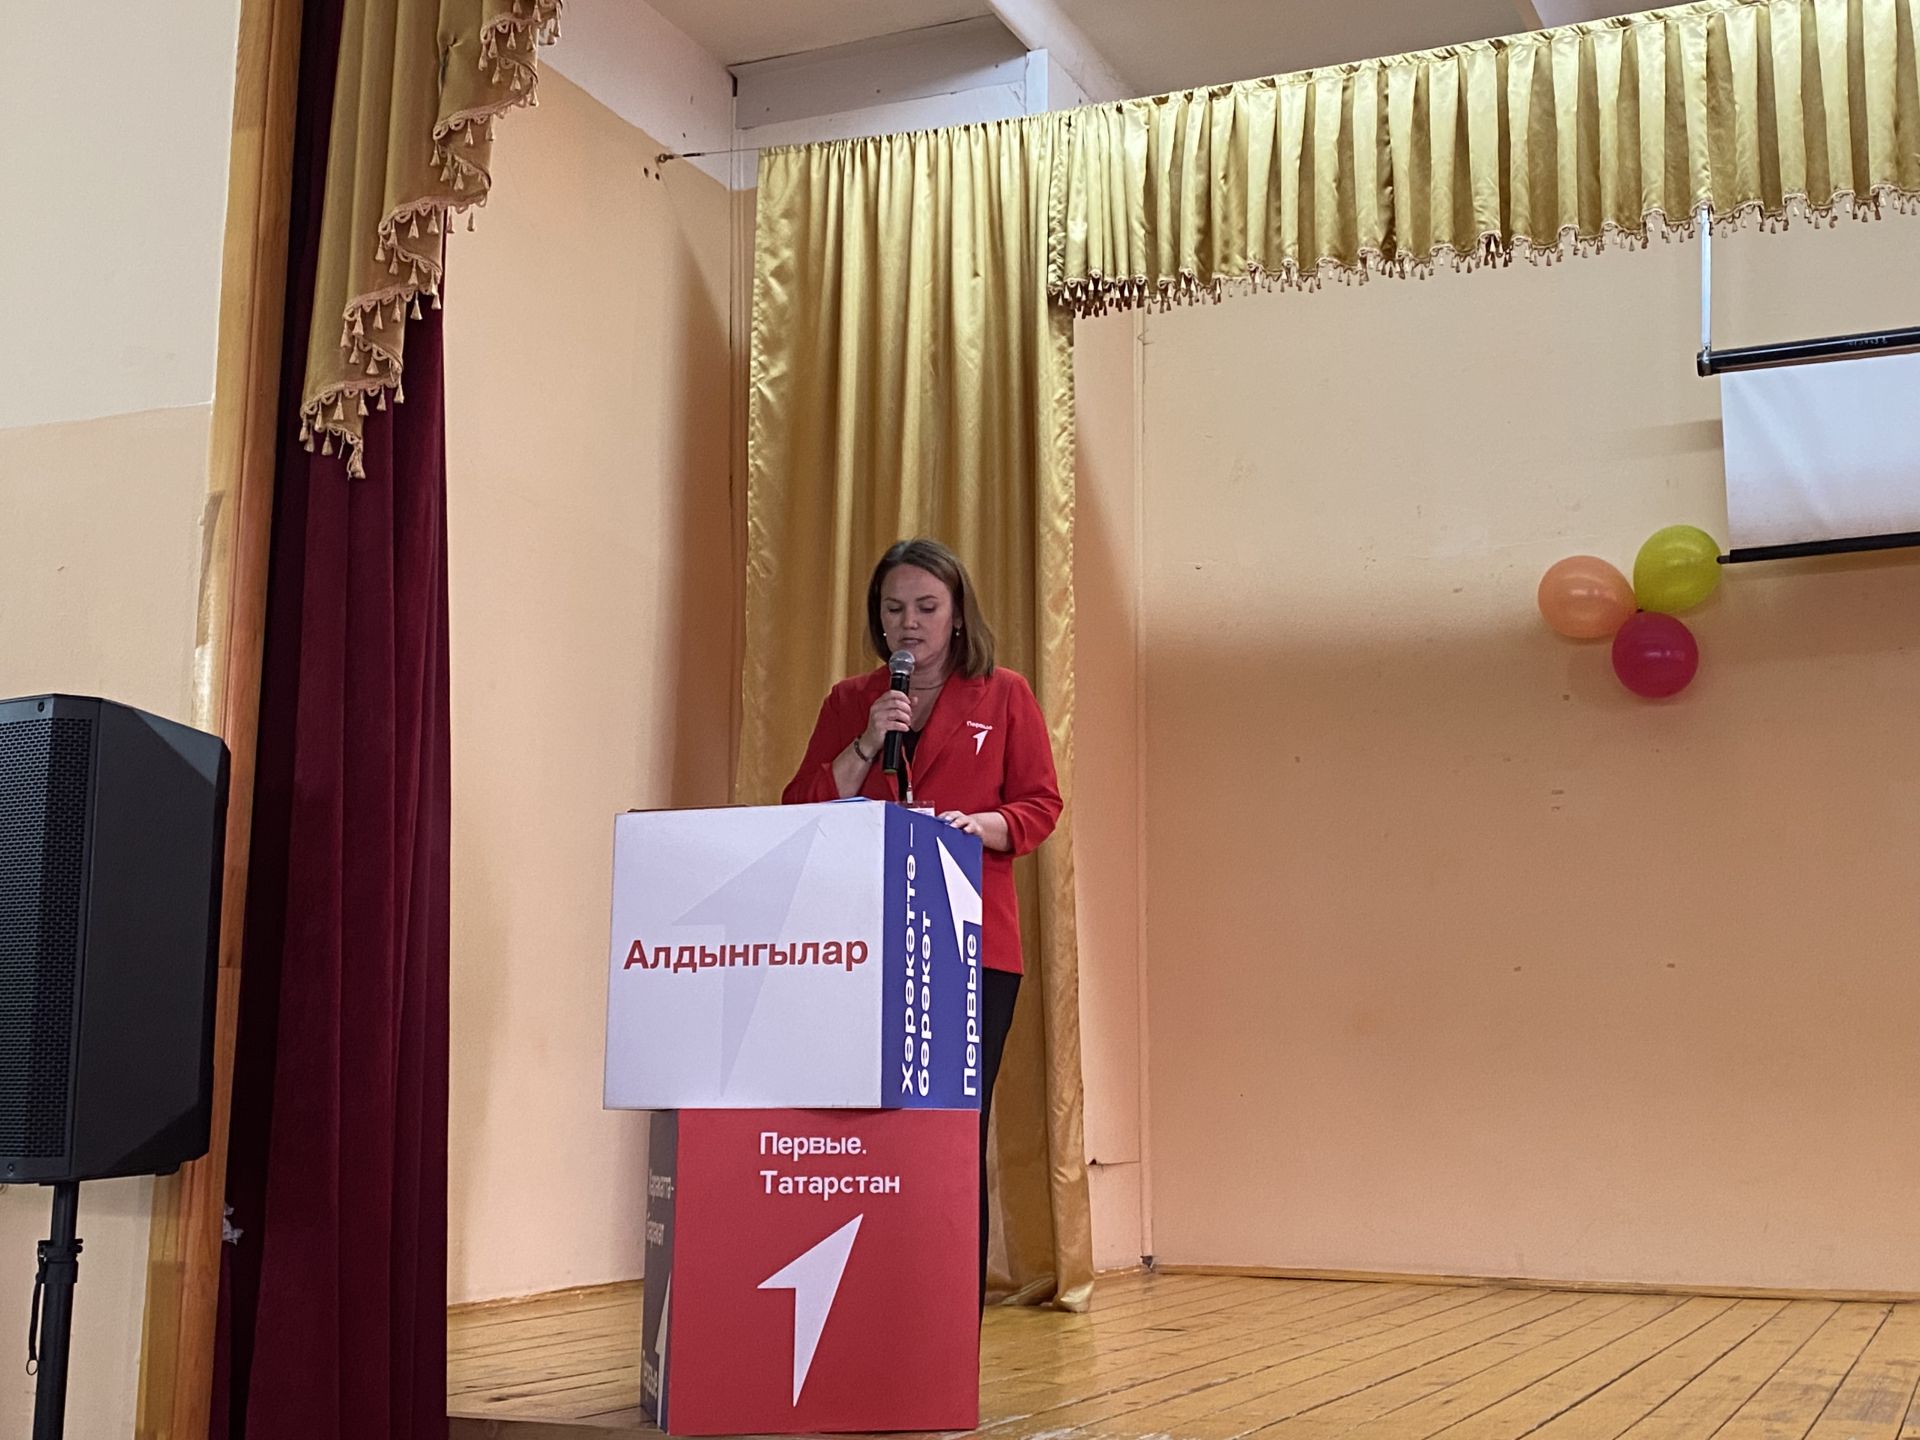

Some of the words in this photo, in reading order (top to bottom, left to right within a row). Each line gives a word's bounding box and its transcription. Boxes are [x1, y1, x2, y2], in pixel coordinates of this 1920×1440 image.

[623, 939, 869, 974] Алдынгылар
[901, 854, 917, 1096] Хәрәкәттә
[917, 910, 932, 1097] бәрәкәт
[963, 933, 980, 1096] Первые
[759, 1131, 867, 1161] Первые.
[759, 1169, 900, 1201] Татарстан
